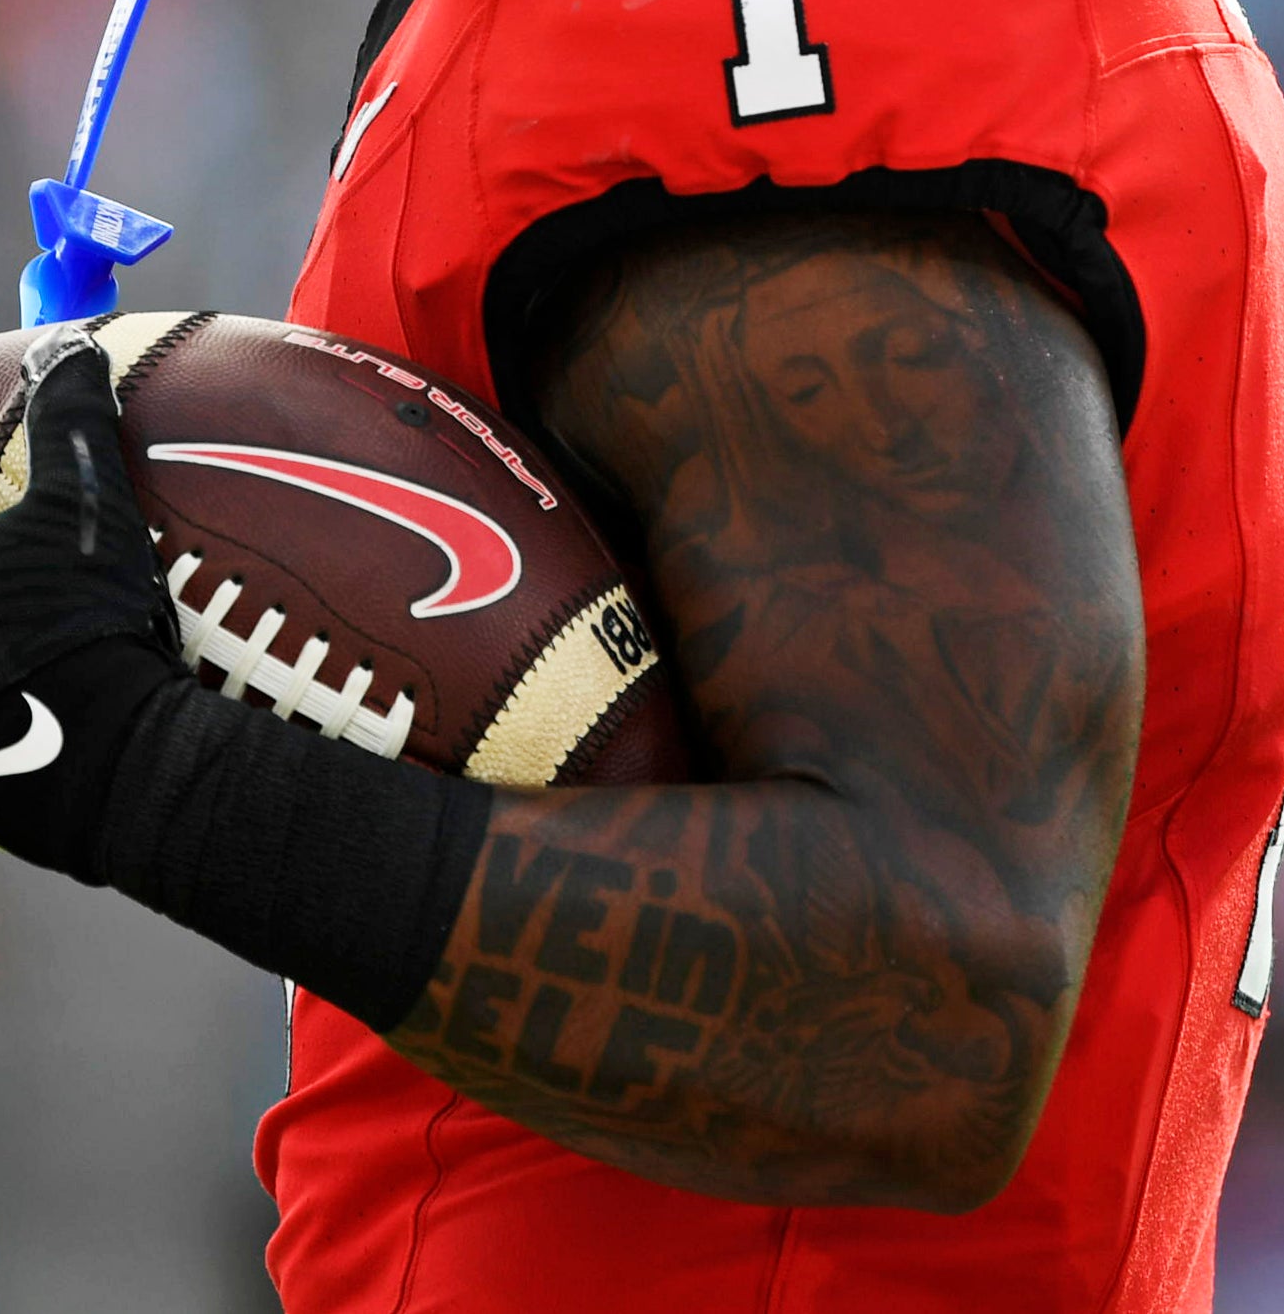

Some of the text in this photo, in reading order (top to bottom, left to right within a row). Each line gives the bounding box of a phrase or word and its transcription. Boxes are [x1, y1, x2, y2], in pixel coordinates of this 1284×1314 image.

[282, 331, 558, 511] VAPOR ELITE
[618, 867, 737, 1017] in
